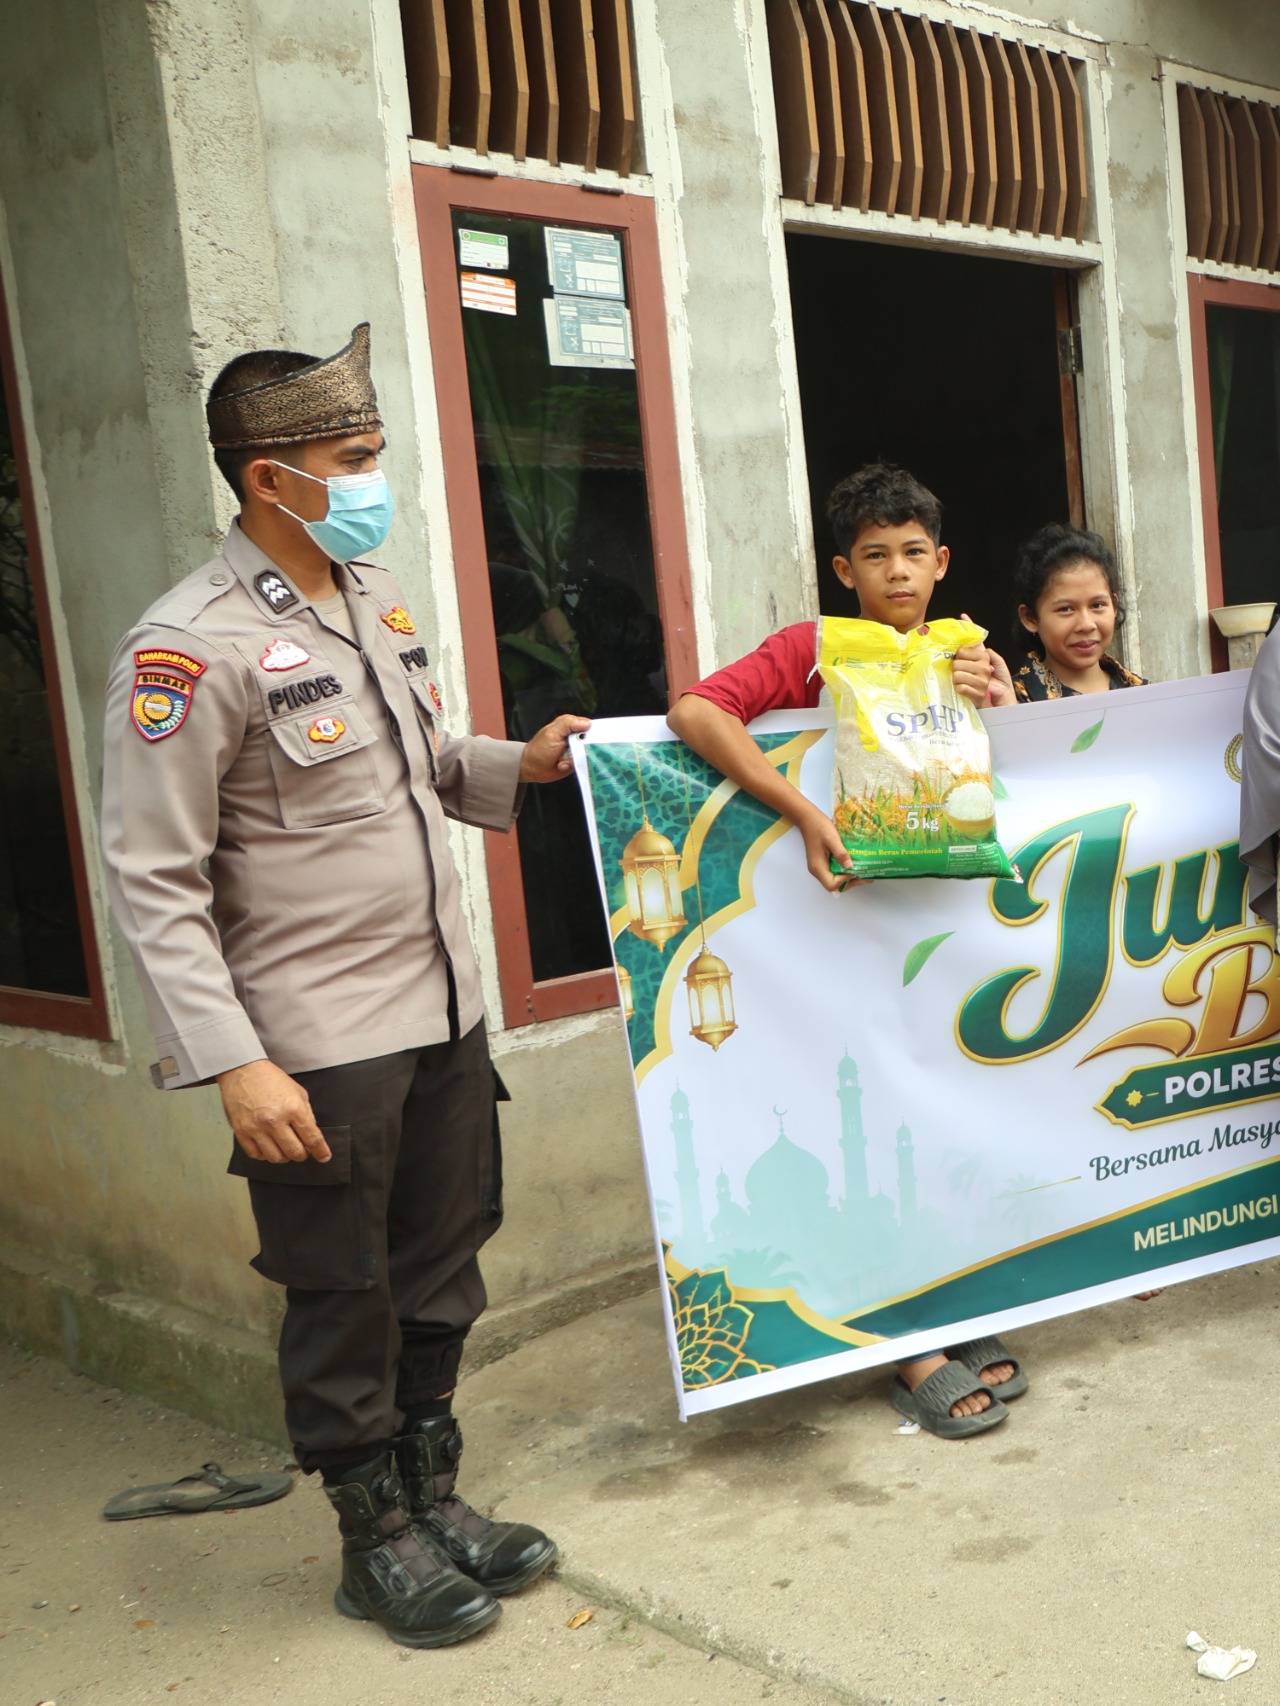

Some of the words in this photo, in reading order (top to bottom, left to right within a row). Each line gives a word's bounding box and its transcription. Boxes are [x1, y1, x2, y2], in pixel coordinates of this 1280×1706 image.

[139, 651, 180, 663] BAHARKAM
[179, 657, 201, 673] POLRI
[142, 675, 186, 691] BINMAS
[268, 674, 343, 715] PINDES
[886, 704, 964, 737] SPHP
[906, 811, 920, 830] 5
[922, 816, 940, 832] kg
[901, 848, 943, 856] Pemerintah
[1089, 1137, 1203, 1181] Bersama
[1134, 1193, 1279, 1252] MELINDUNGI
